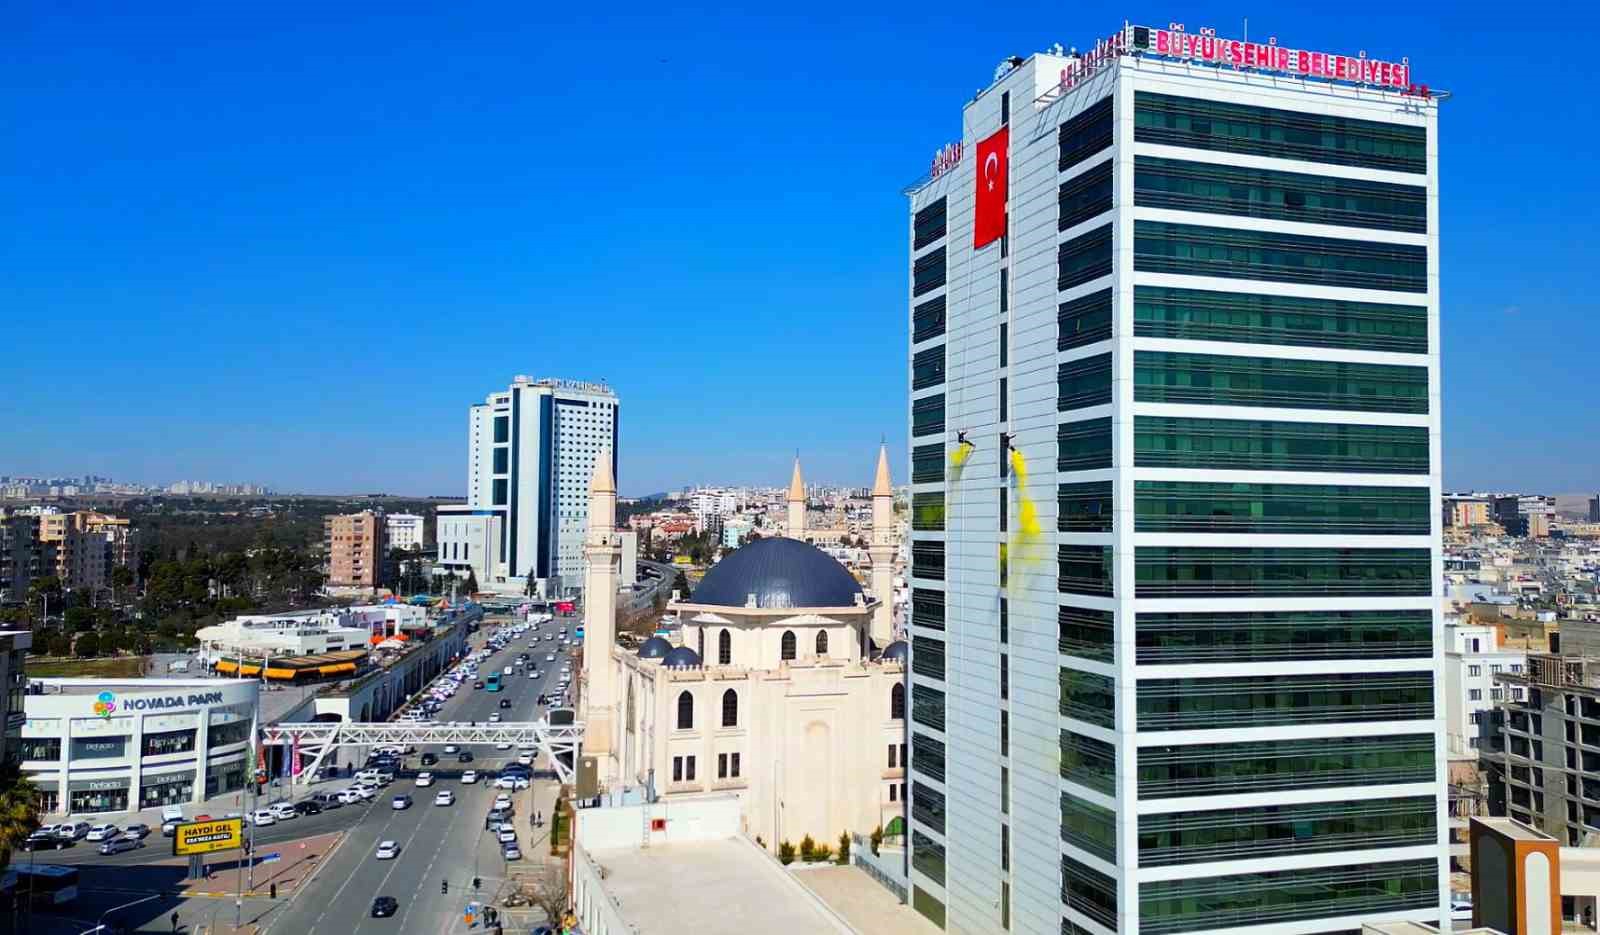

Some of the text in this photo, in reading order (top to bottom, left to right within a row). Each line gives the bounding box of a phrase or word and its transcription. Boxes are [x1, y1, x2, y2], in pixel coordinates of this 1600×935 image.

[1156, 22, 1410, 87] BÜYÜKŞEHİR BELEDİYESİ
[123, 692, 223, 710] NOVADA PARK
[184, 824, 232, 836] HAYDİ GEL
